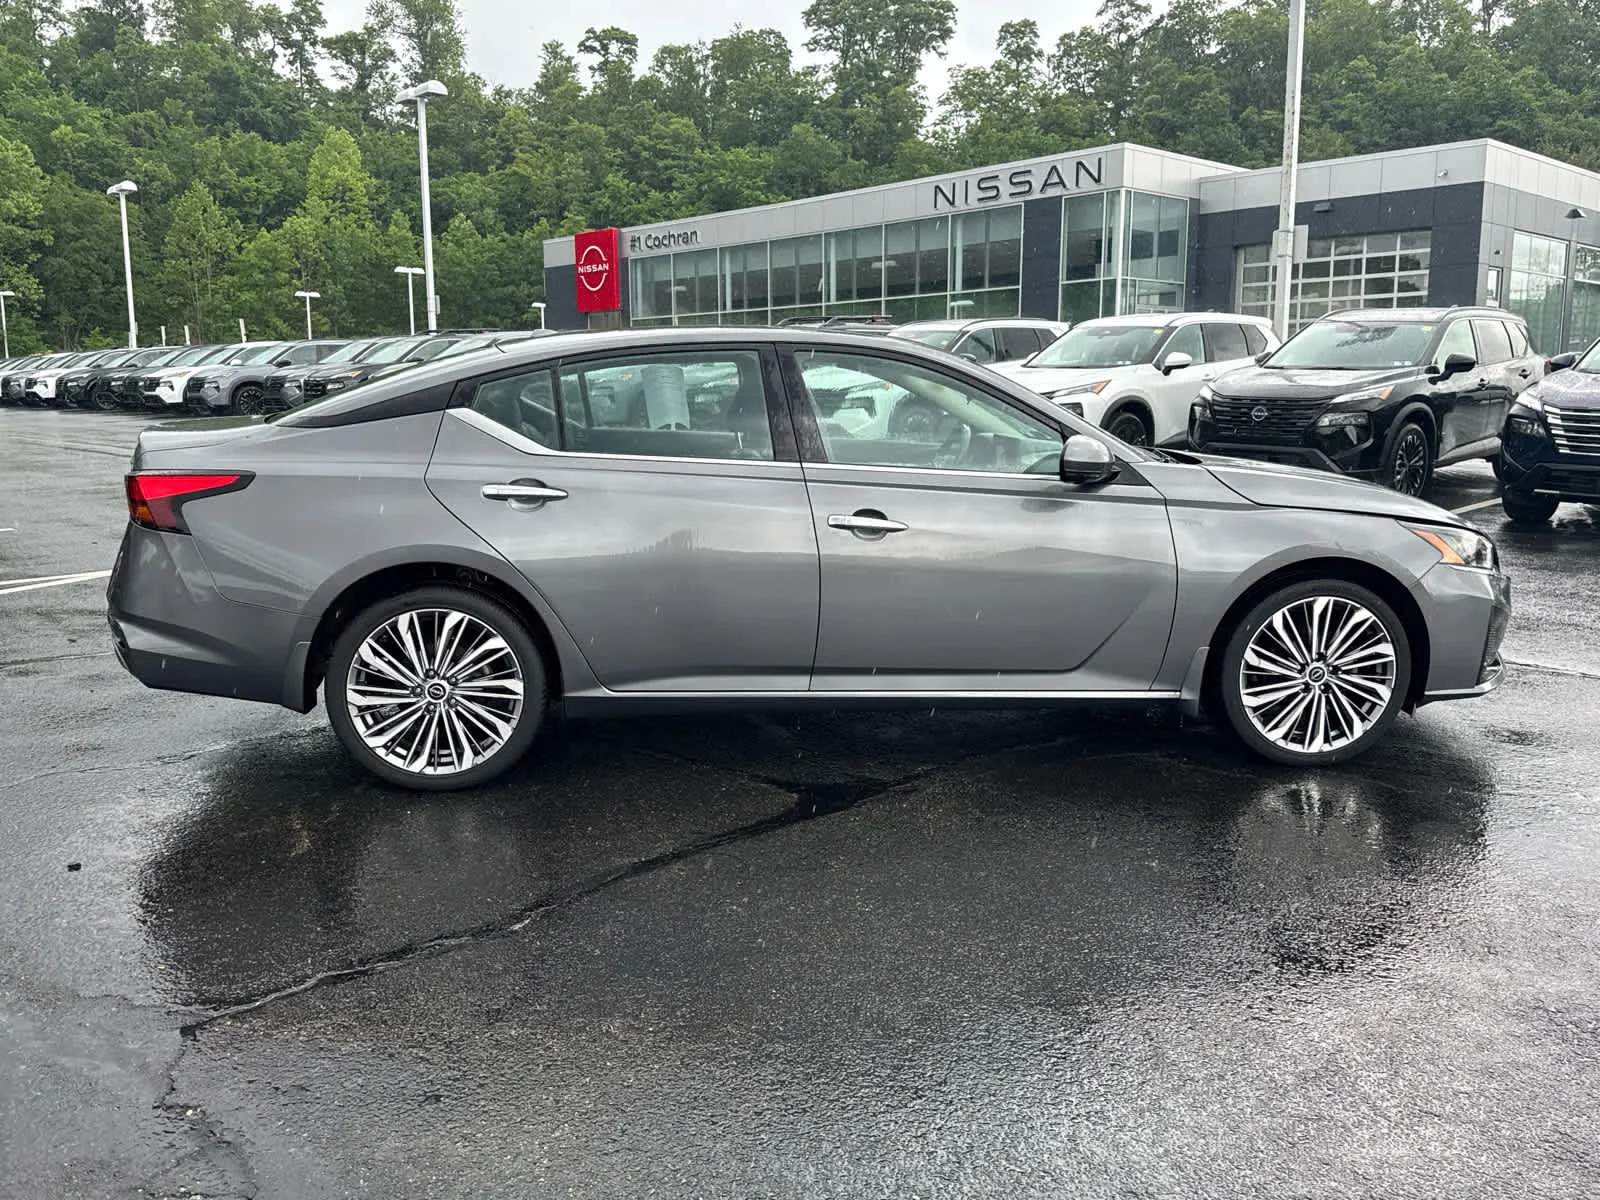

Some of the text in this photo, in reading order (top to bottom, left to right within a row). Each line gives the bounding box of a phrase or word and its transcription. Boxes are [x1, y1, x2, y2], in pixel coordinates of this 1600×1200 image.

[933, 157, 1102, 209] NISSAN
[630, 230, 699, 252] #1 Cochran
[578, 263, 609, 274] NISSAN
